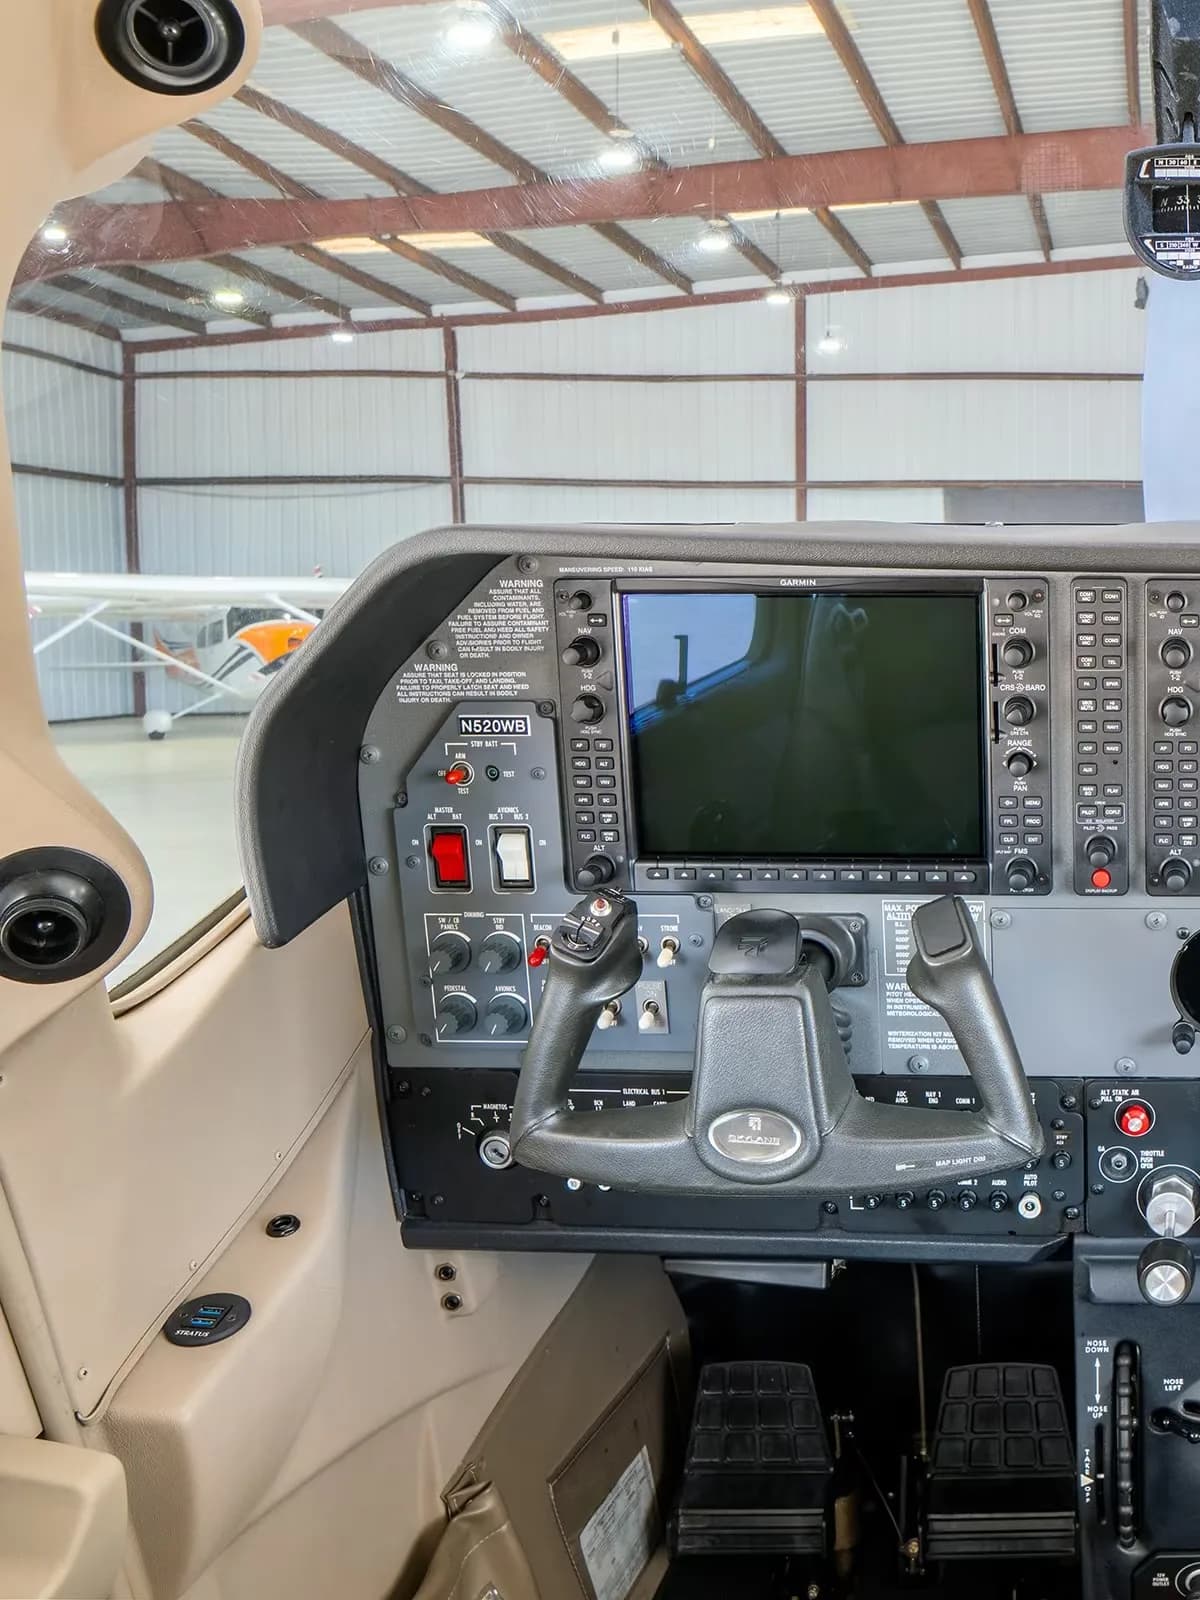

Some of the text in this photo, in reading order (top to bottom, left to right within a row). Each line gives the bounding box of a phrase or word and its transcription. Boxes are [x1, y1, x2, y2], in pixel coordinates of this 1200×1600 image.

[1161, 198, 1168, 206] N
[1176, 195, 1189, 204] 33
[499, 579, 544, 588] WARNING
[577, 627, 592, 635] NAV
[414, 664, 458, 672] WARNING
[580, 684, 596, 692] HDG
[461, 720, 526, 733] N520WB
[1007, 739, 1033, 747] RANGE
[1013, 784, 1028, 792] PAN
[952, 1157, 972, 1165] LIGHT
[1026, 1160, 1032, 1168] 5
[1059, 1159, 1065, 1167] 5
[869, 1198, 875, 1206] 5
[932, 1199, 937, 1207] 5
[964, 1200, 969, 1208] 5
[995, 1201, 1001, 1209] 5
[1027, 1202, 1033, 1210] 5
[175, 1329, 210, 1337] STRATUS
[1164, 1384, 1183, 1392] LEFT
